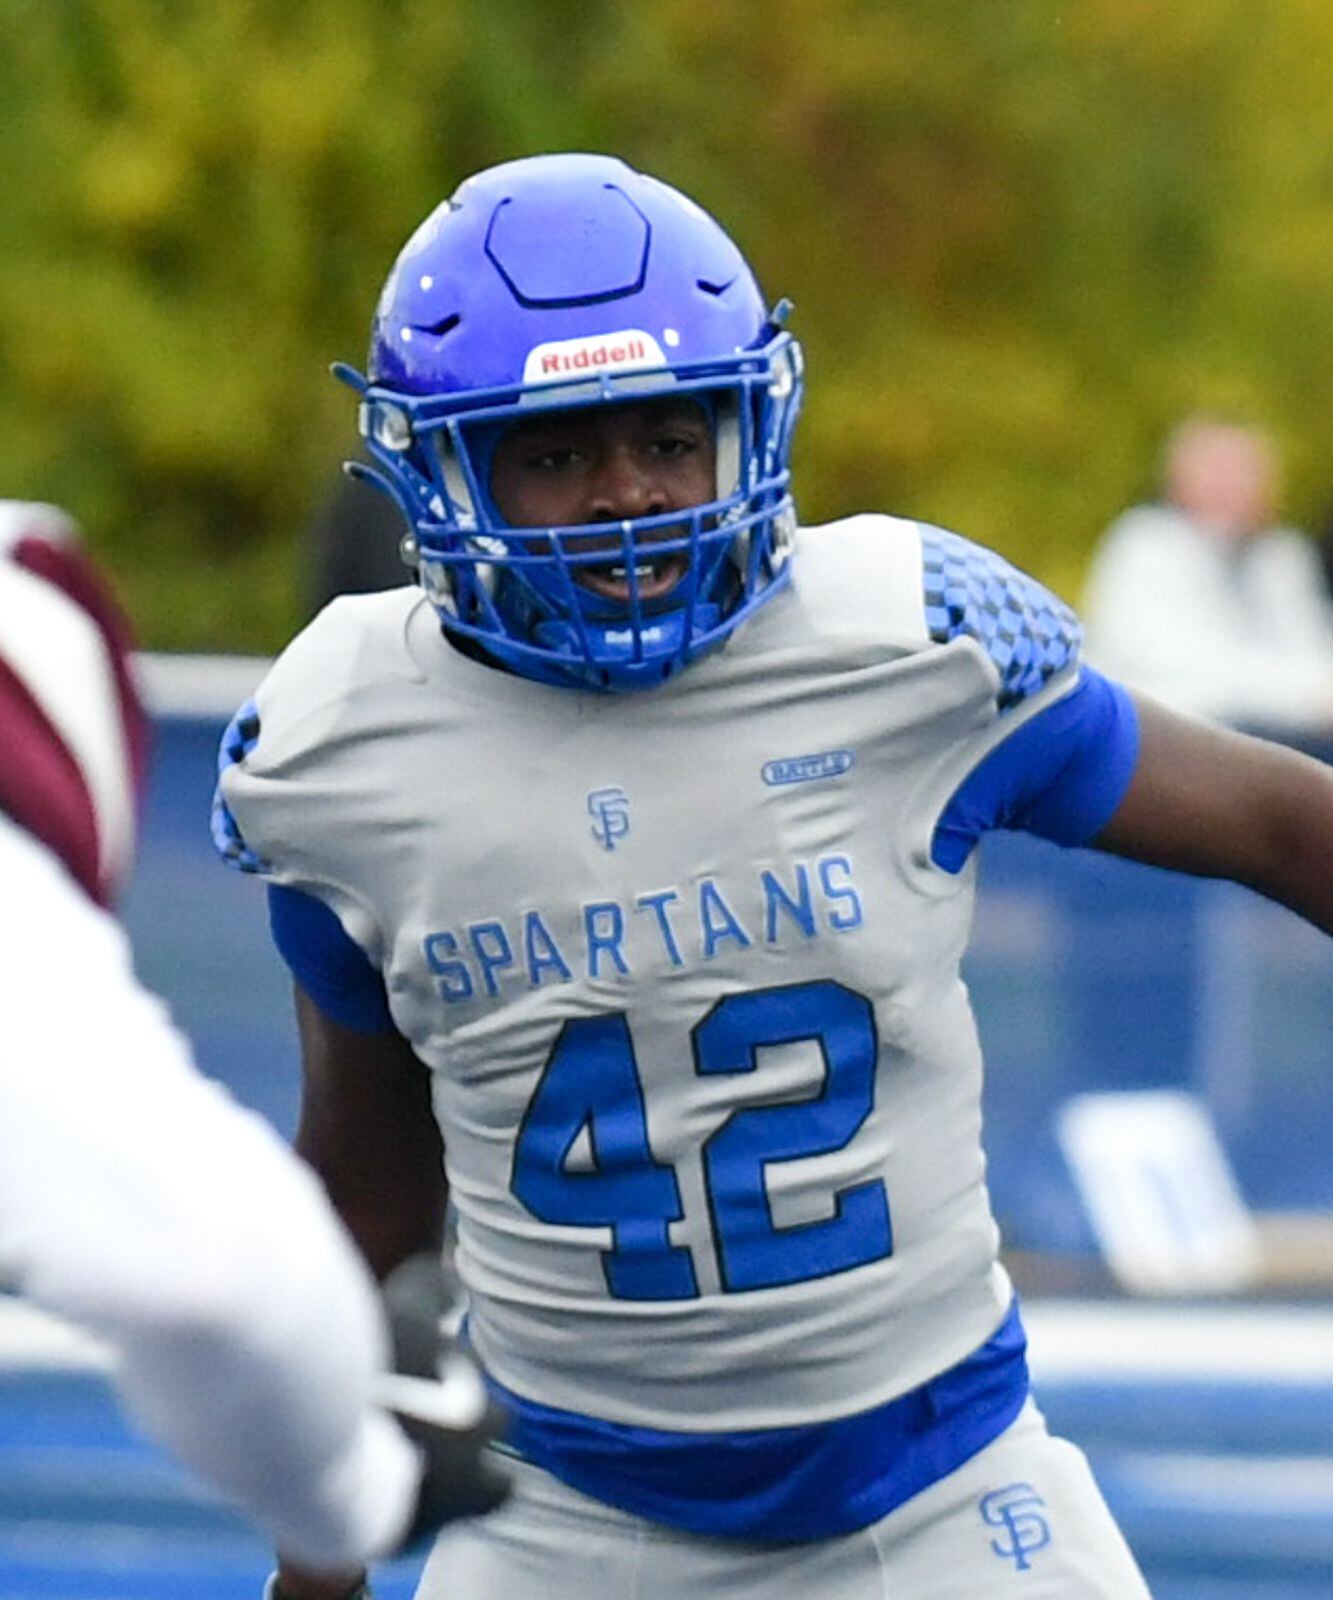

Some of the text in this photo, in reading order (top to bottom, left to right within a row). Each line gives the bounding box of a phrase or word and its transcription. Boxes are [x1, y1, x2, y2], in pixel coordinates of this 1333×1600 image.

[541, 340, 645, 374] Riddell
[424, 857, 863, 1001] SPARTANS
[510, 979, 893, 1300] 42
